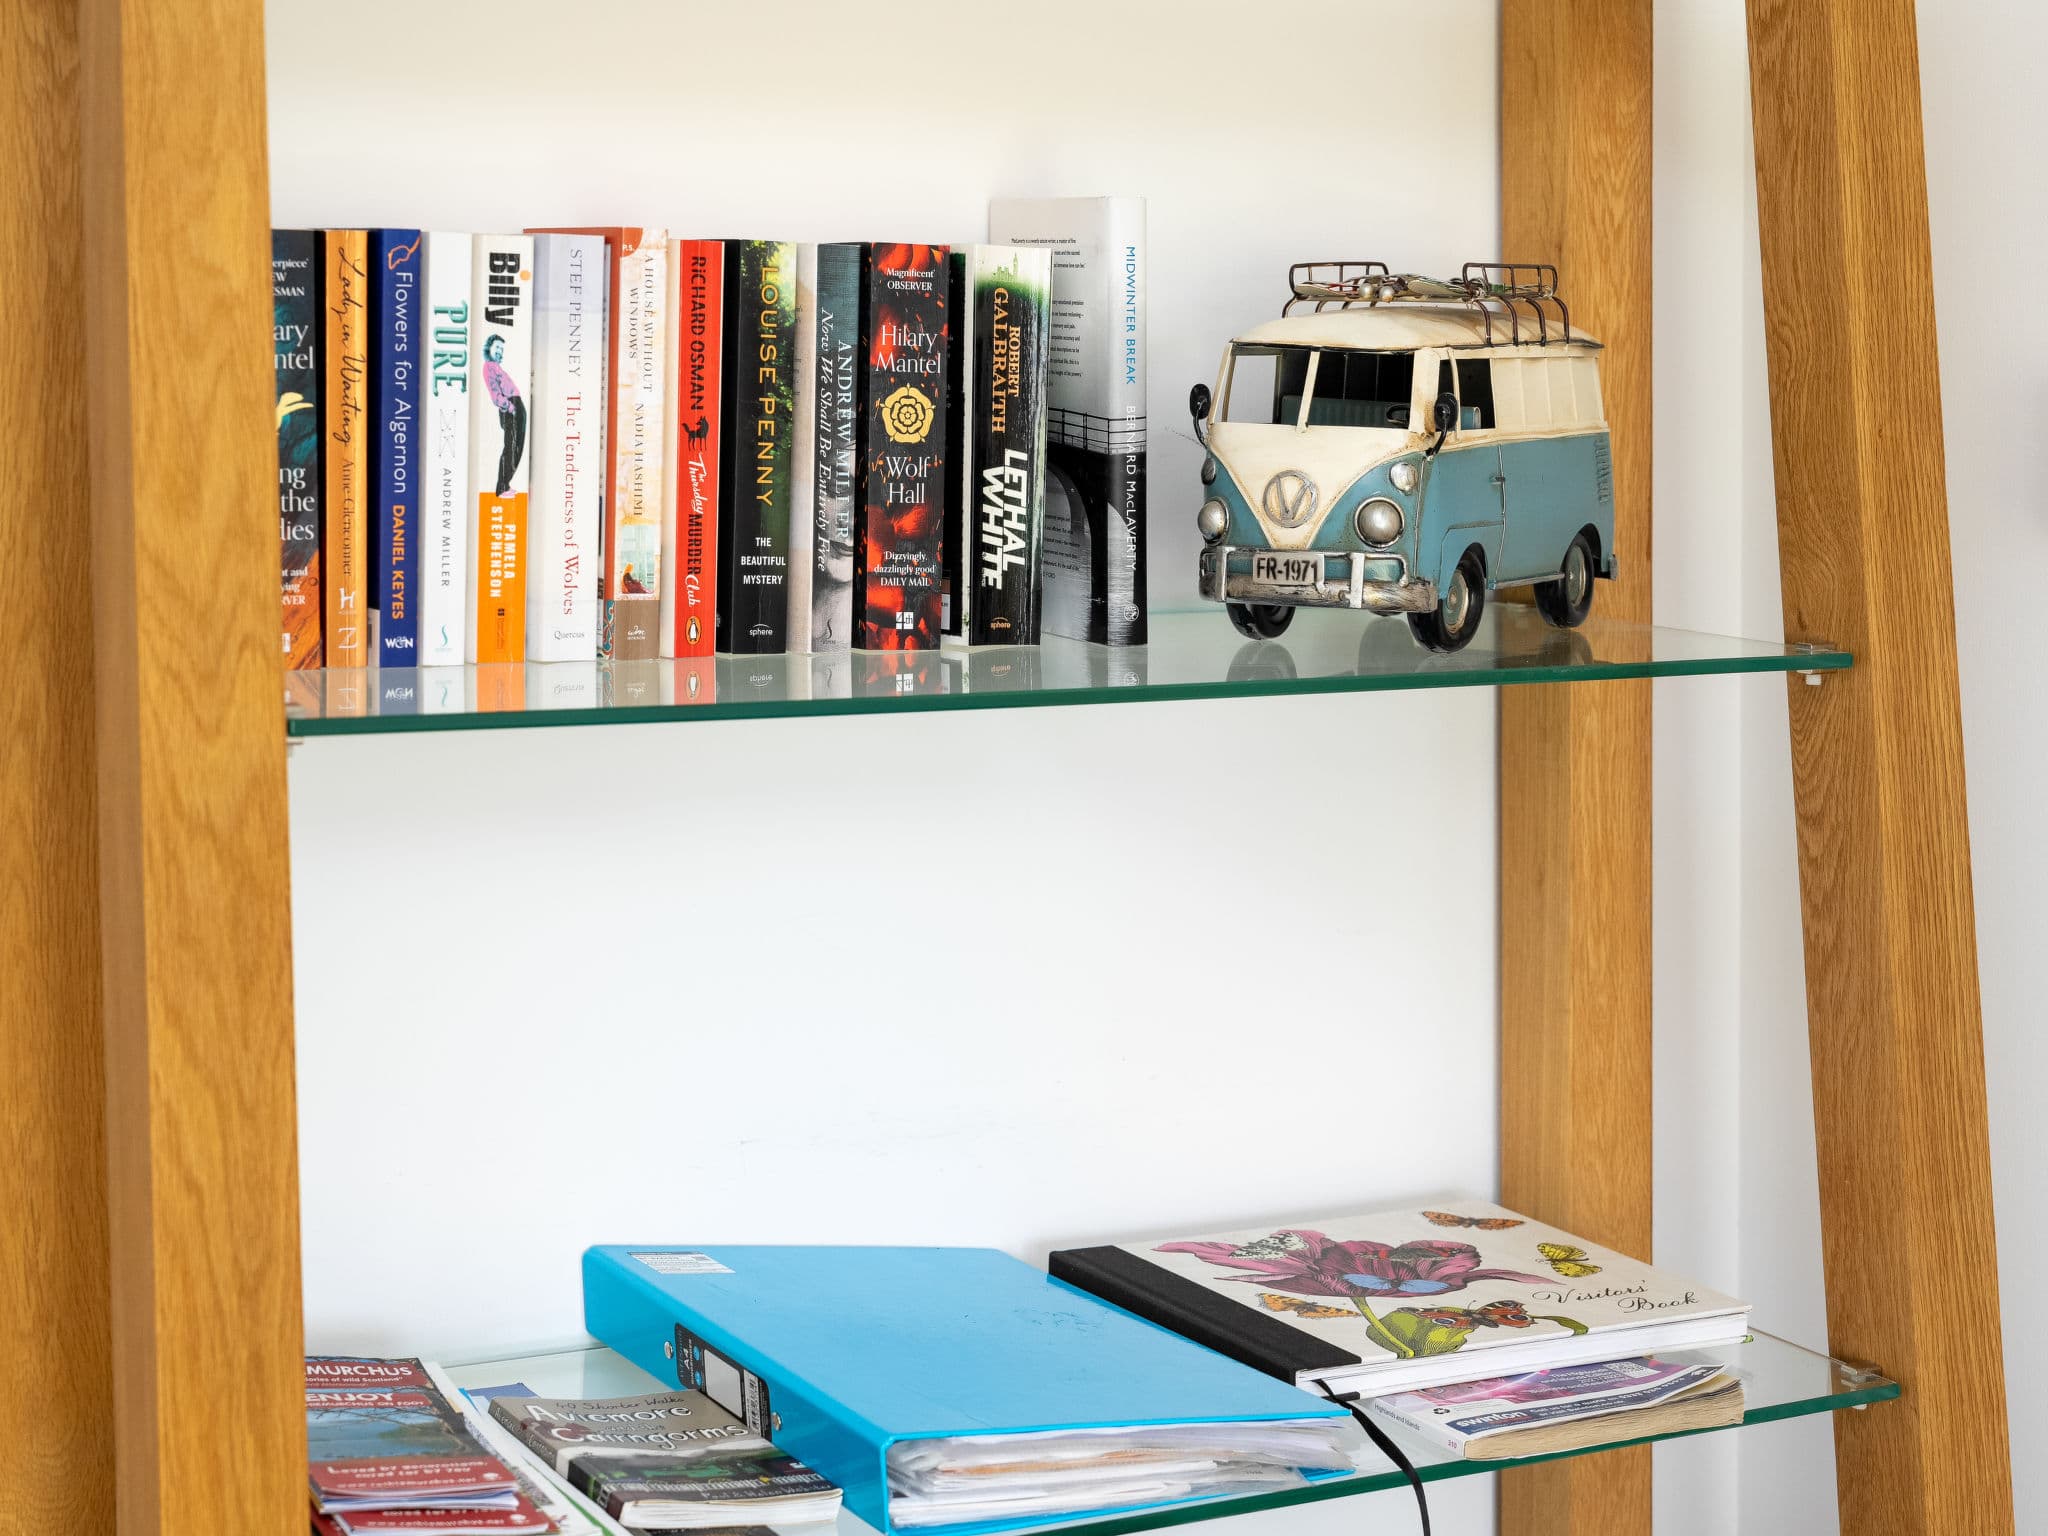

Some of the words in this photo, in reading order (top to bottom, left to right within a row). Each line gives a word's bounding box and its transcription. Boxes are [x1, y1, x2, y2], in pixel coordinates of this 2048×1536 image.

[331, 247, 365, 322] Lady
[485, 252, 526, 327] Billy
[569, 249, 583, 295] STEF
[643, 267, 654, 318] HOUSE
[887, 282, 933, 291] OBSERVER
[1126, 246, 1136, 332] MIDWINTER
[394, 272, 413, 352] Flowers
[629, 287, 638, 359] WINDOWS
[759, 266, 779, 384] LOUISE
[821, 308, 833, 351] Now
[273, 325, 309, 347] ary
[343, 323, 354, 347] in
[433, 300, 469, 398] PURE
[568, 302, 582, 377] PENNEY
[643, 322, 654, 392] WITHOUT
[881, 325, 938, 353] Hilary
[274, 346, 314, 370] ntel
[394, 361, 412, 391] for
[690, 340, 705, 411] OSMAN
[820, 356, 833, 384] We
[875, 351, 941, 374] Mantel
[991, 287, 1009, 434] GALBRAITH
[1008, 325, 1021, 397] ROBERT
[1126, 339, 1136, 385] BREAK
[334, 354, 366, 447] Waiting
[566, 392, 581, 427] The
[819, 387, 833, 433] Shall
[836, 340, 853, 443] ANDREW
[389, 398, 411, 494] Algernon
[634, 403, 645, 447] NADIA
[1126, 405, 1136, 475] BERNARD
[756, 397, 776, 506] PENNY
[819, 438, 832, 458] Be
[886, 456, 931, 478] Wolf
[280, 467, 305, 490] ng
[442, 467, 452, 529] ANDREW
[564, 432, 581, 524] Tenderness
[633, 453, 643, 516] HASHIMI
[687, 452, 708, 515] Thursday
[815, 466, 832, 531] Entirely
[835, 448, 851, 539] MILLER
[888, 482, 925, 504] Hall
[281, 489, 315, 513] the
[1002, 448, 1028, 571] LETHAL
[392, 504, 405, 566] DANIEL
[564, 528, 579, 548] of
[687, 514, 703, 575] MURDER
[755, 537, 772, 547] THE
[982, 466, 1005, 590] WHITE
[290, 566, 308, 577] and
[441, 536, 451, 587] MILLER
[490, 505, 503, 598] STEPHENSON
[504, 524, 516, 579] PAMELA
[740, 556, 786, 566] BEAUTIFUL
[817, 536, 831, 572] Free
[873, 564, 913, 574] dazzlingly
[1256, 557, 1319, 581] FR-1971
[391, 570, 404, 620] KEYES
[563, 555, 580, 616] Wolves
[685, 574, 701, 607] Club
[743, 575, 783, 585] MYSTERY
[880, 577, 906, 587] DAILY
[908, 577, 930, 587] MAIL
[553, 630, 585, 640] Quercus
[749, 628, 773, 637] sphere
[1532, 1280, 1648, 1303] Visitors'
[1618, 1292, 1698, 1313] Book
[305, 1365, 412, 1376] MURCHUS
[524, 1404, 693, 1423] Aviemore
[583, 1400, 642, 1411] Shorter
[644, 1398, 686, 1406] Walks
[1374, 1403, 1396, 1419] Highlands
[1404, 1419, 1420, 1431] Islands
[1455, 1410, 1528, 1427] swinton
[551, 1424, 750, 1449] Cairngorms
